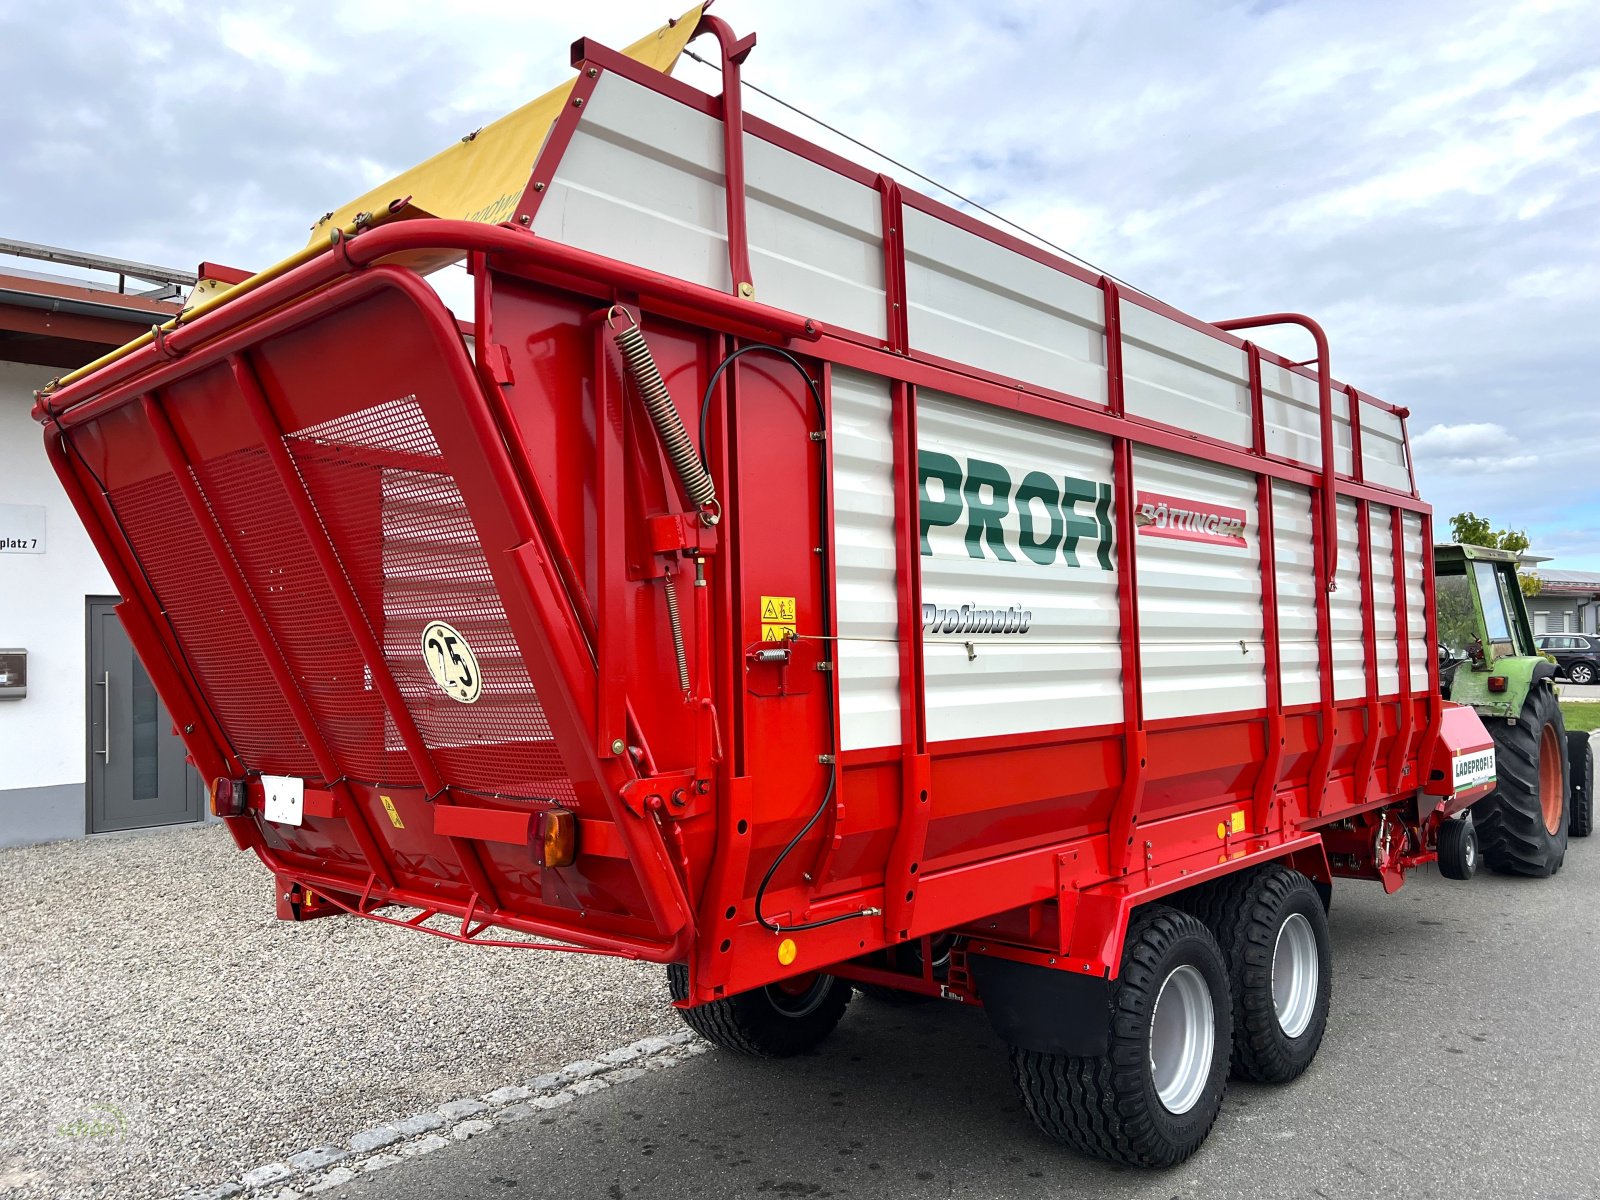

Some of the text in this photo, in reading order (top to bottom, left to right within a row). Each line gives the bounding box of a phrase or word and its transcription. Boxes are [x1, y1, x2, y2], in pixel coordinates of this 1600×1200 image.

[918, 449, 1113, 571] PROFI
[31, 539, 37, 549] 7
[922, 601, 1032, 634] Profimatic
[428, 636, 473, 687] 25
[1456, 756, 1489, 777] LADEPROFI
